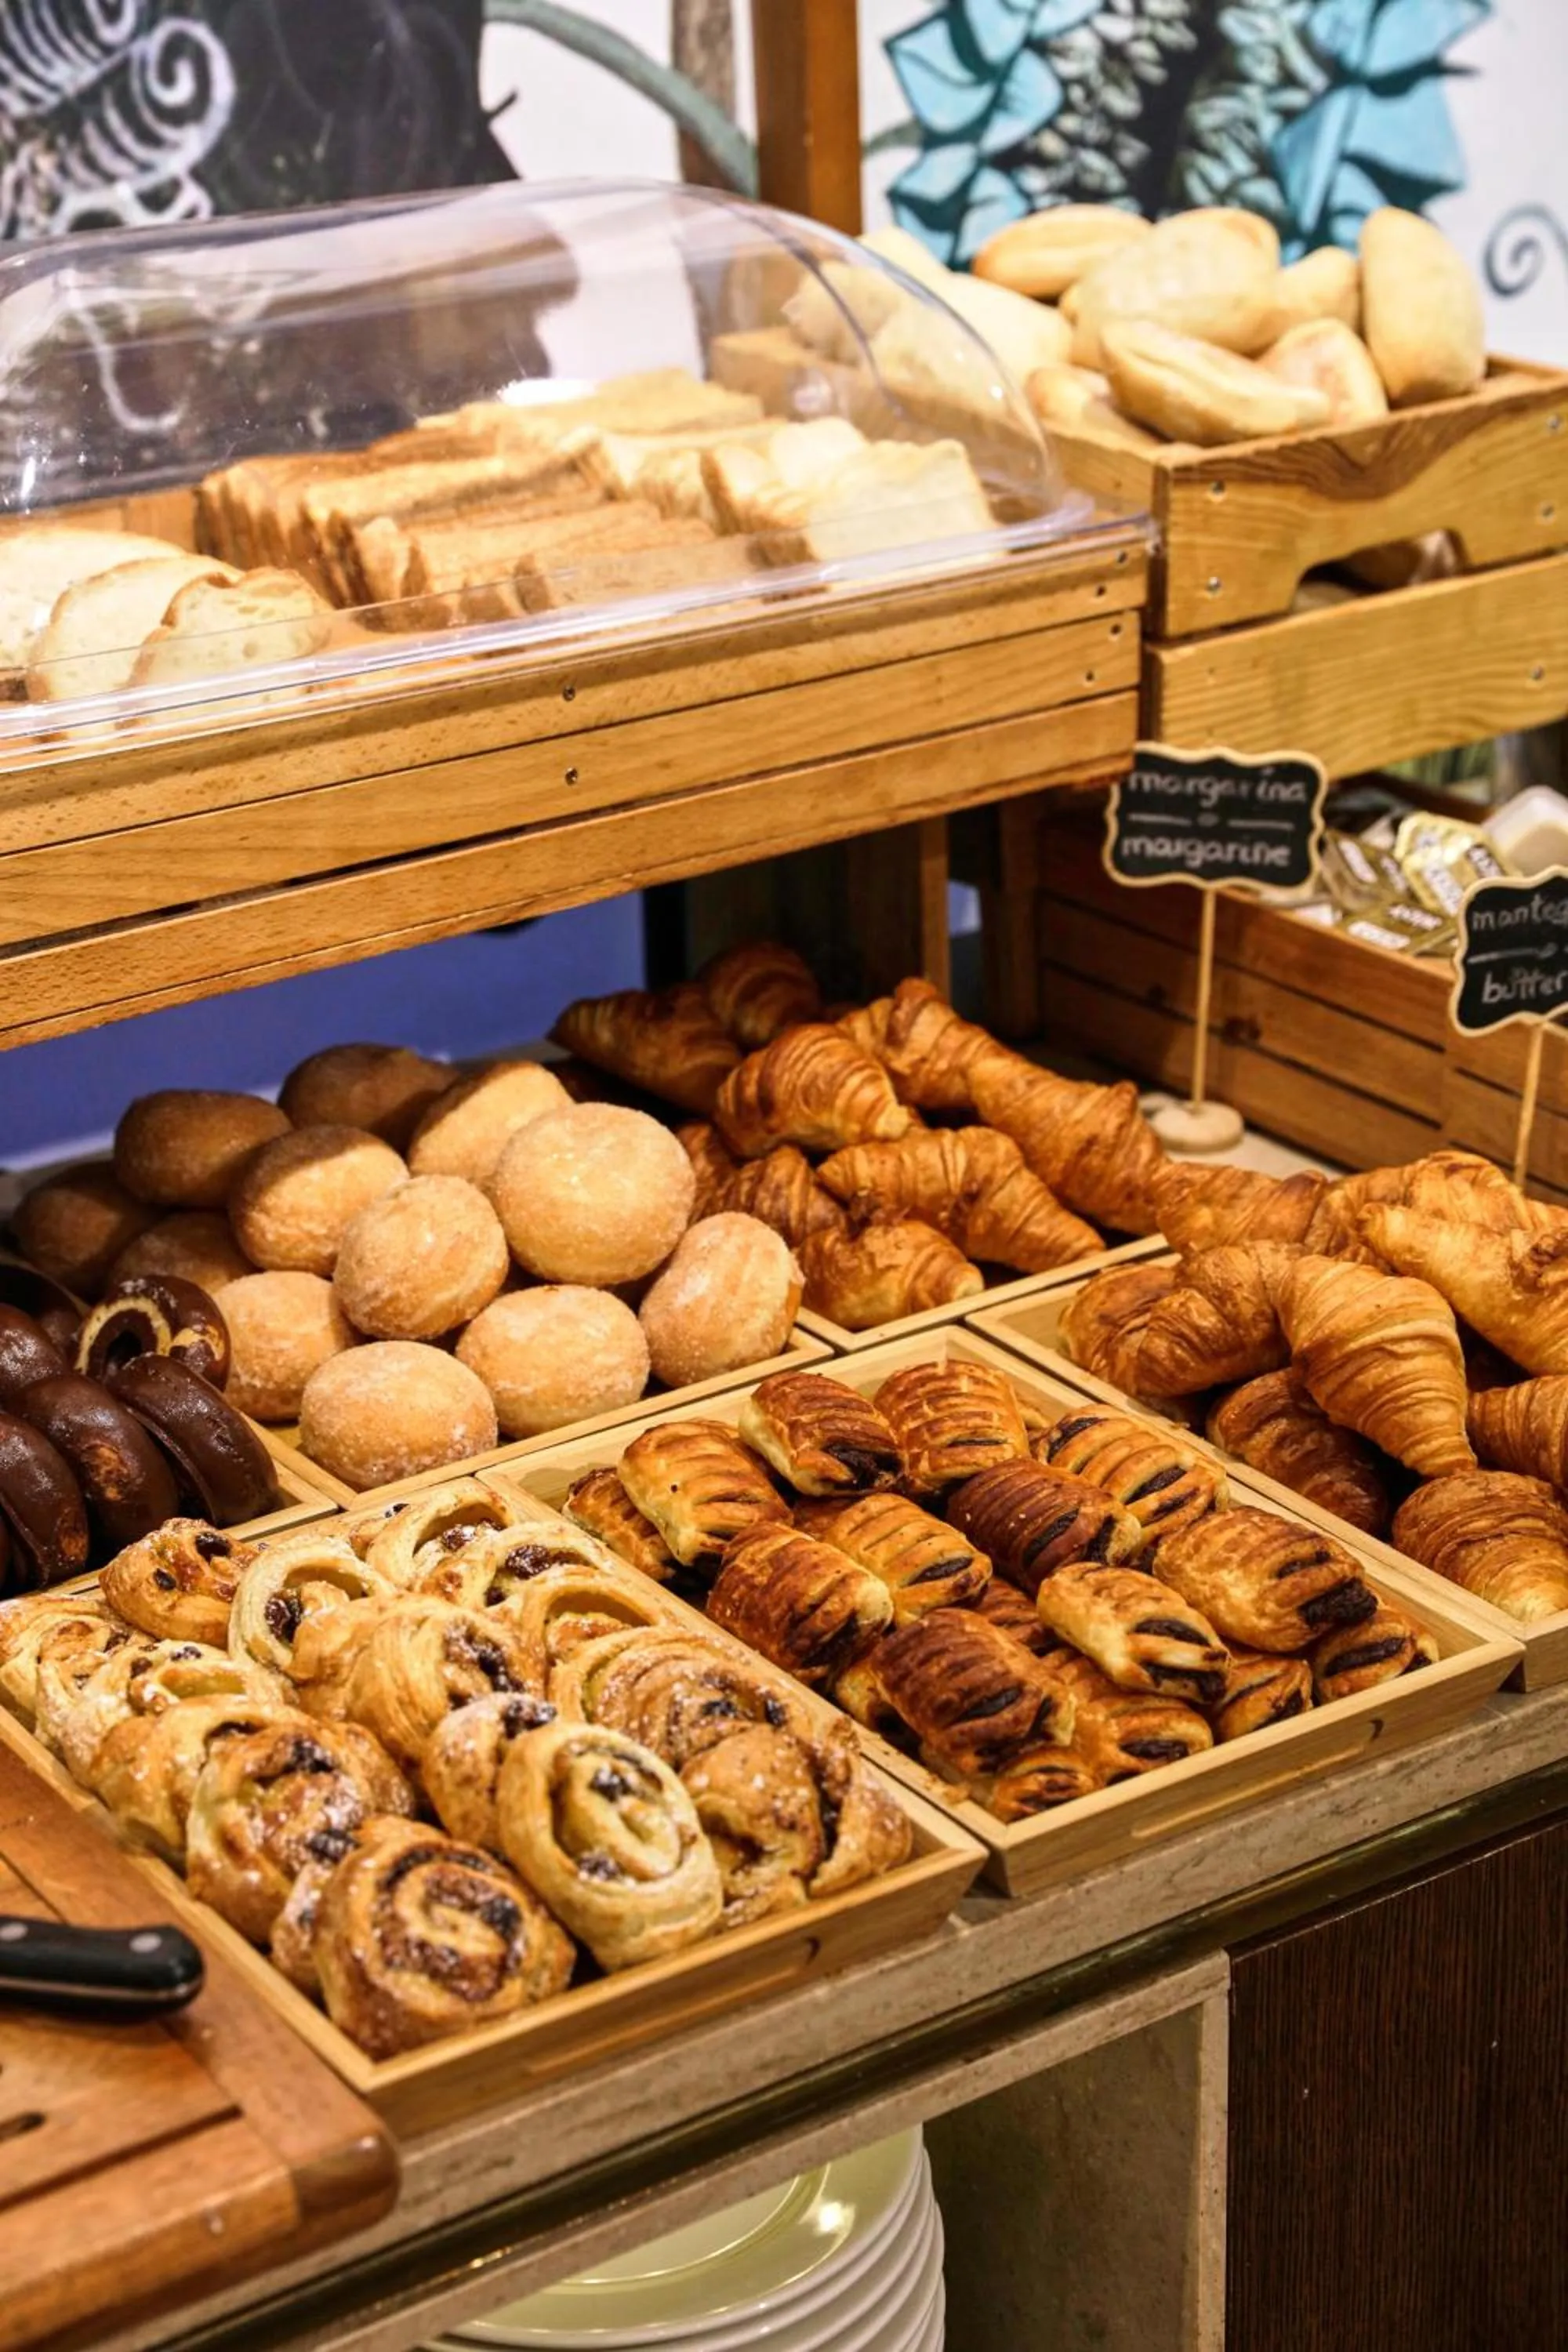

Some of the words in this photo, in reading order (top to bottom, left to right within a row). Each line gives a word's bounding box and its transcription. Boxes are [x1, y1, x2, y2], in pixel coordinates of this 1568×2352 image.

[1129, 766, 1307, 807] margarina
[1121, 834, 1291, 868] margarine
[1481, 967, 1568, 1004] butter
